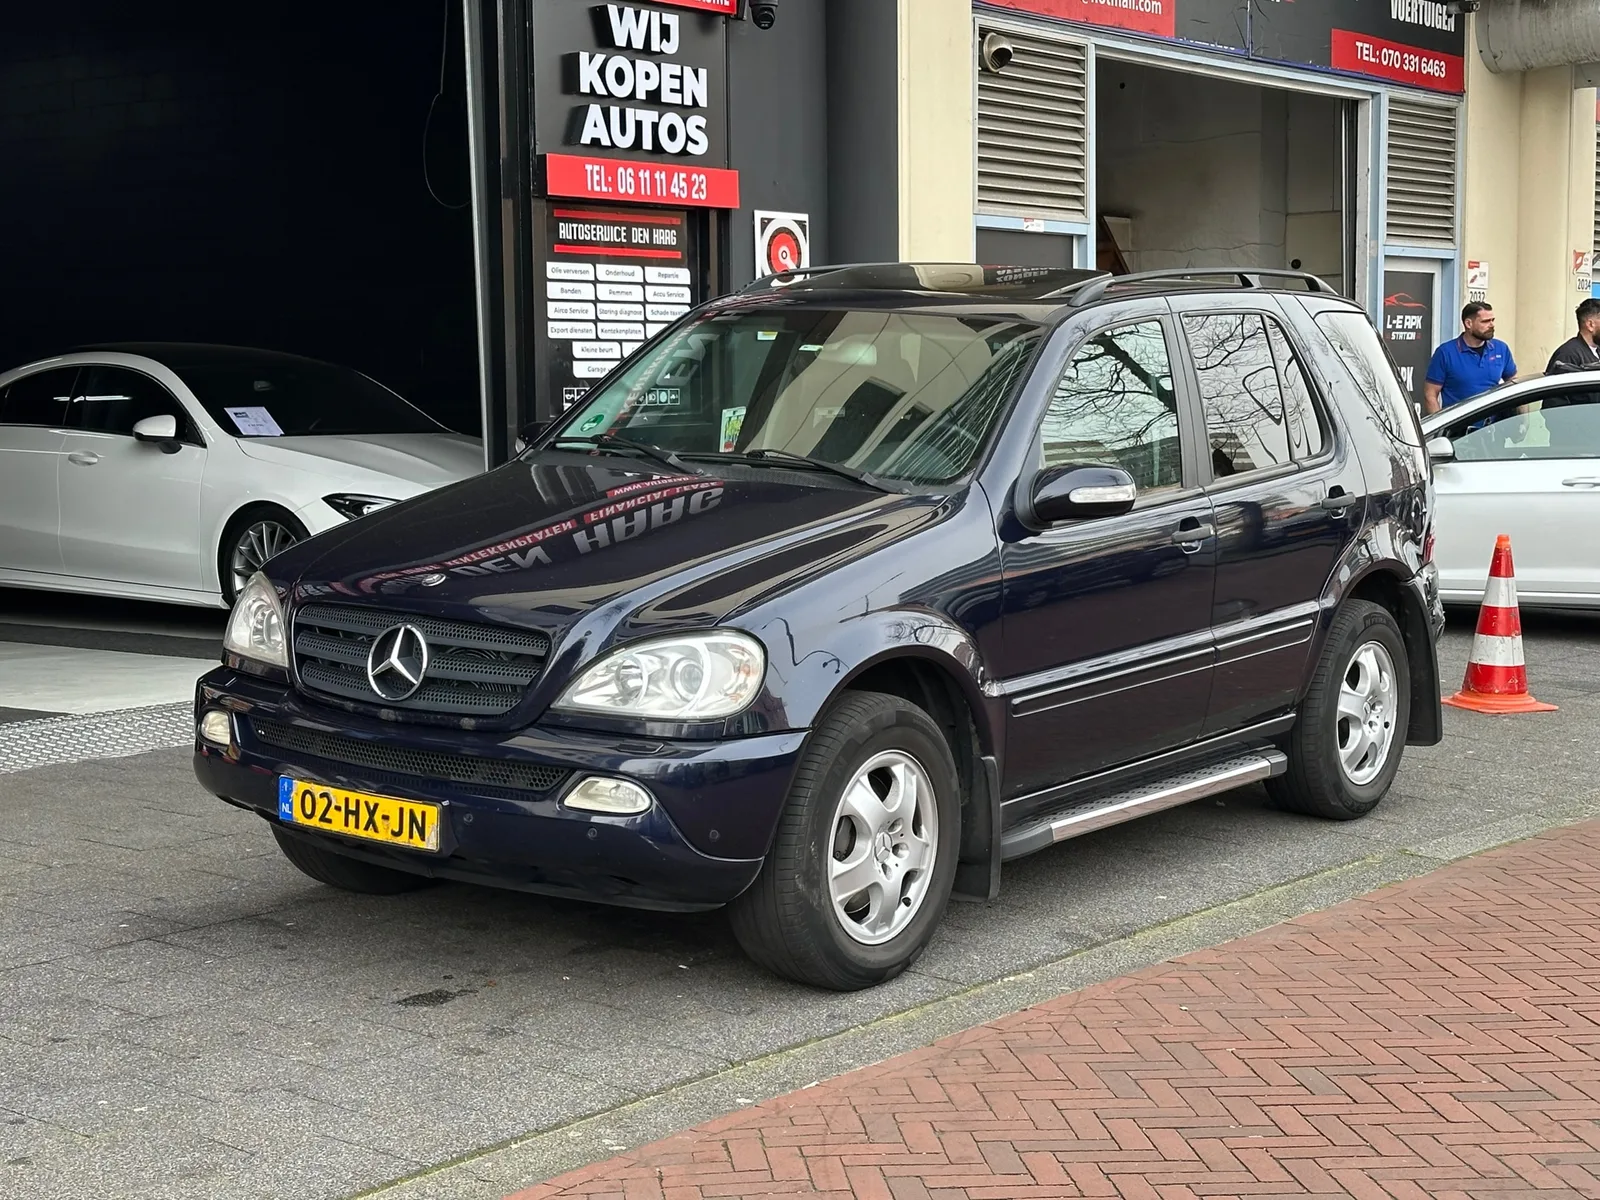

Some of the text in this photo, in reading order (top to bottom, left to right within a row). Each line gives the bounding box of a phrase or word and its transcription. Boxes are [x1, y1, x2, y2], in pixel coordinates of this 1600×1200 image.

[607, 4, 680, 54] WIJ
[1356, 41, 1446, 79] TEL: 070 331 6463
[579, 51, 708, 108] KOPEN
[580, 104, 709, 155] AUTOS
[585, 164, 707, 200] TEL: 06 11 11 45 23
[559, 222, 677, 245] AUTOSERVICE DEN HAAG
[605, 269, 635, 277] Onderhoud
[1577, 278, 1592, 290] 2034
[1469, 290, 1486, 303] 2032
[1403, 315, 1423, 329] APK
[1391, 331, 1417, 340] STATION
[1398, 366, 1414, 391] PK
[281, 803, 292, 814] NL
[300, 789, 426, 841] 02-HX-JN
